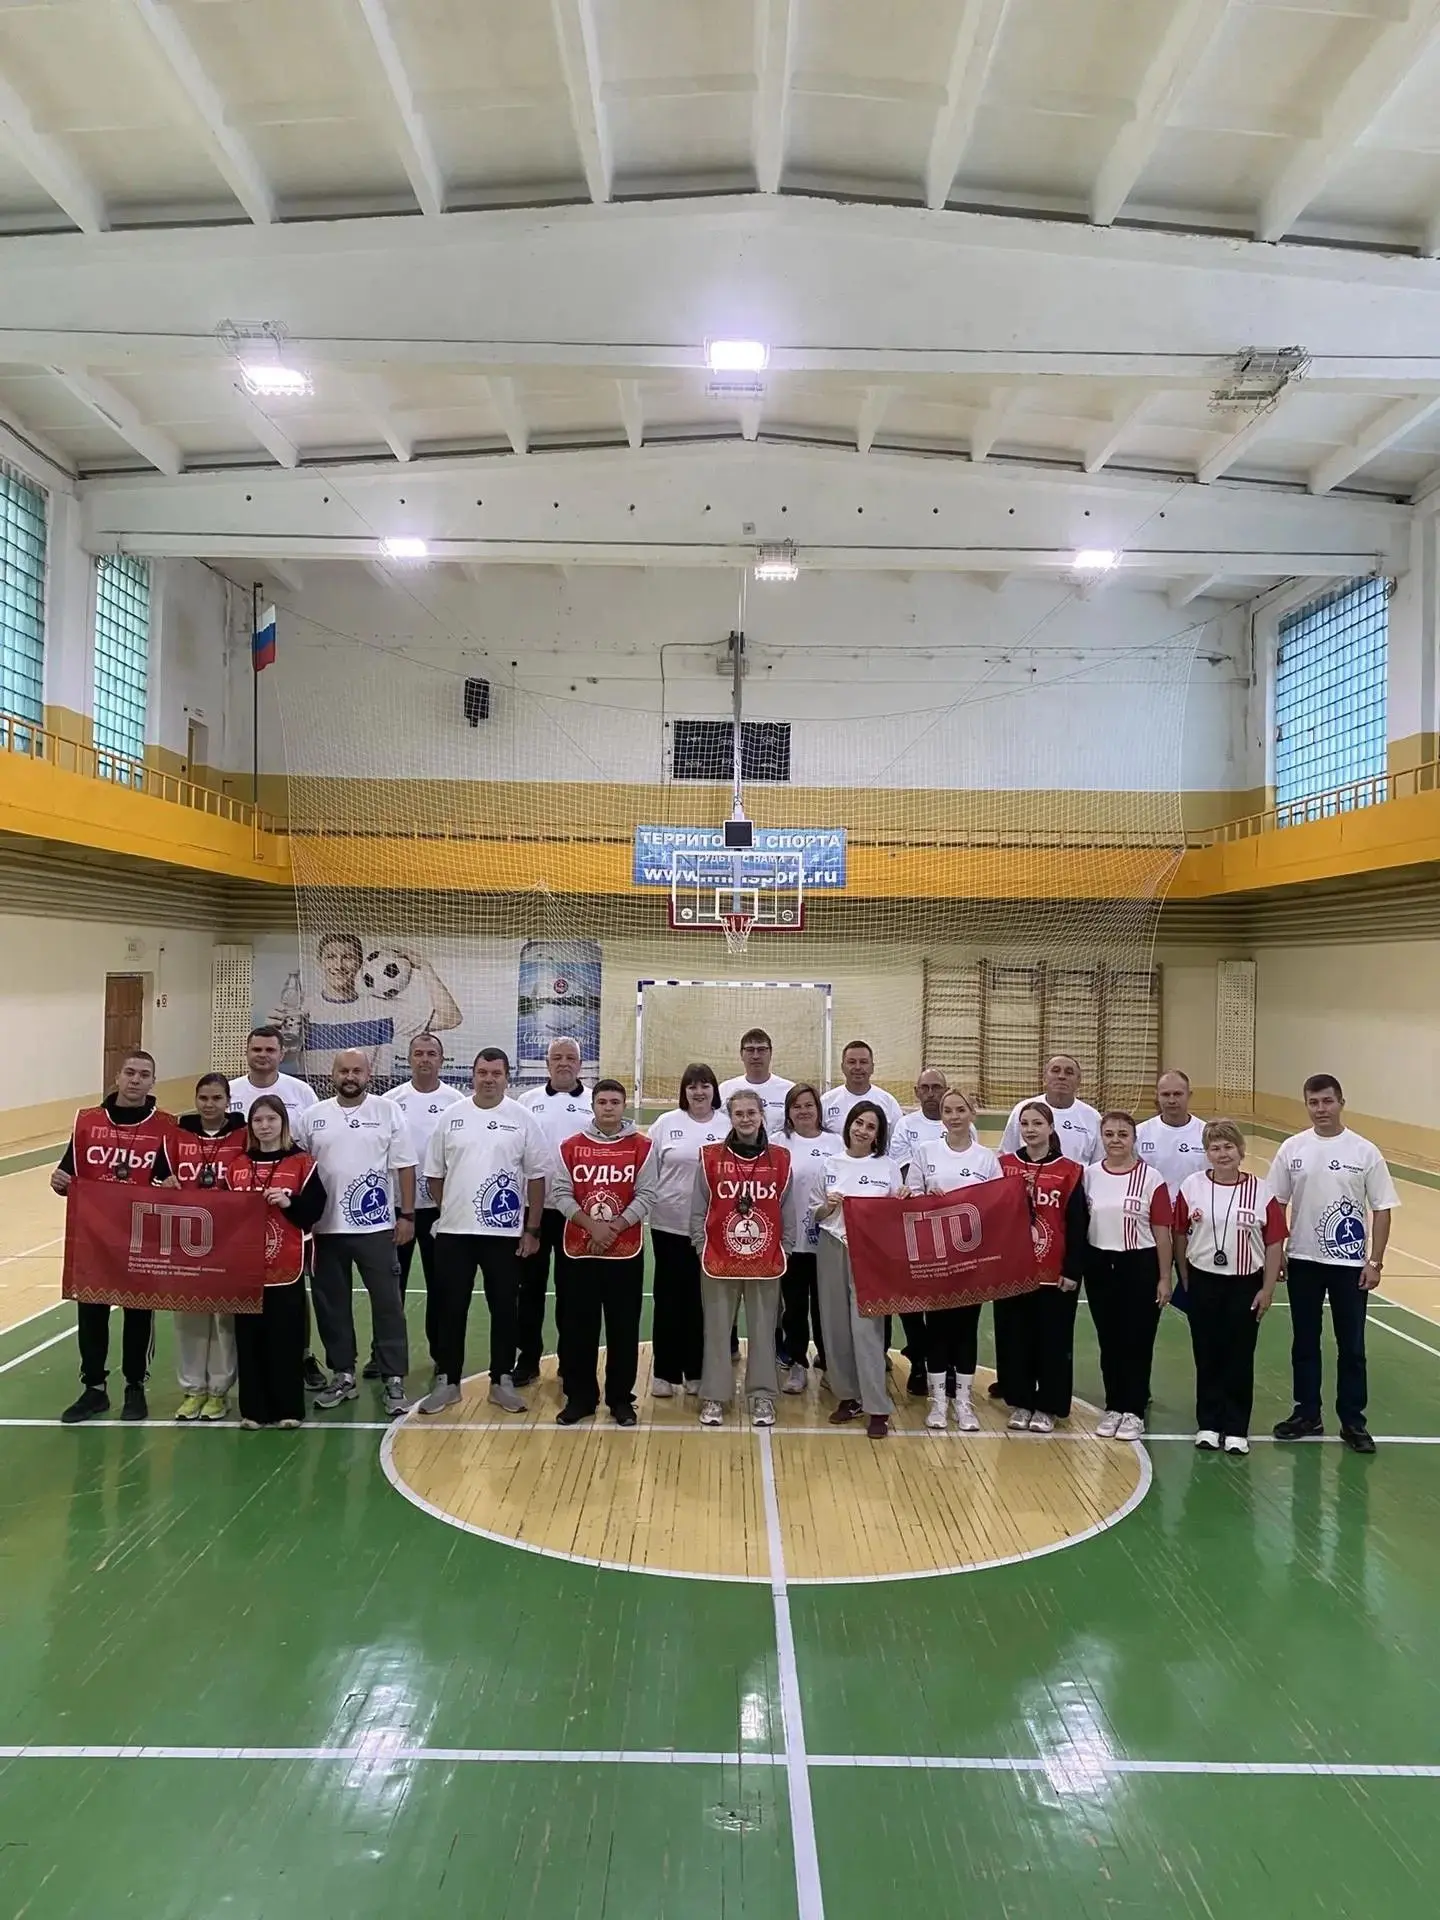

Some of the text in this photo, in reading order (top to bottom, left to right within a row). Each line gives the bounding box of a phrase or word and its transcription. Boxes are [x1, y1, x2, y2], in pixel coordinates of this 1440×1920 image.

[640, 831, 841, 849] ТЕРРИТОЯ СПОРТА
[450, 1119, 464, 1129] ГТО
[91, 1126, 108, 1139] ГТО
[670, 1130, 684, 1139] ГТО
[179, 1143, 197, 1156] ГТО
[574, 1145, 592, 1158] ГТО
[1141, 1142, 1155, 1151] ГТО
[87, 1145, 157, 1170] СУДЬЯ
[573, 1164, 635, 1186] СУДЬЯ
[717, 1180, 777, 1201] СУДЬЯ
[1123, 1198, 1141, 1212] ГТО
[368, 1207, 382, 1219] ГТО
[499, 1211, 513, 1221] ГТО
[1237, 1210, 1256, 1224] ГТО
[130, 1201, 213, 1258] ГТО
[903, 1202, 983, 1262] ГТО
[1344, 1241, 1360, 1253] ГТО
